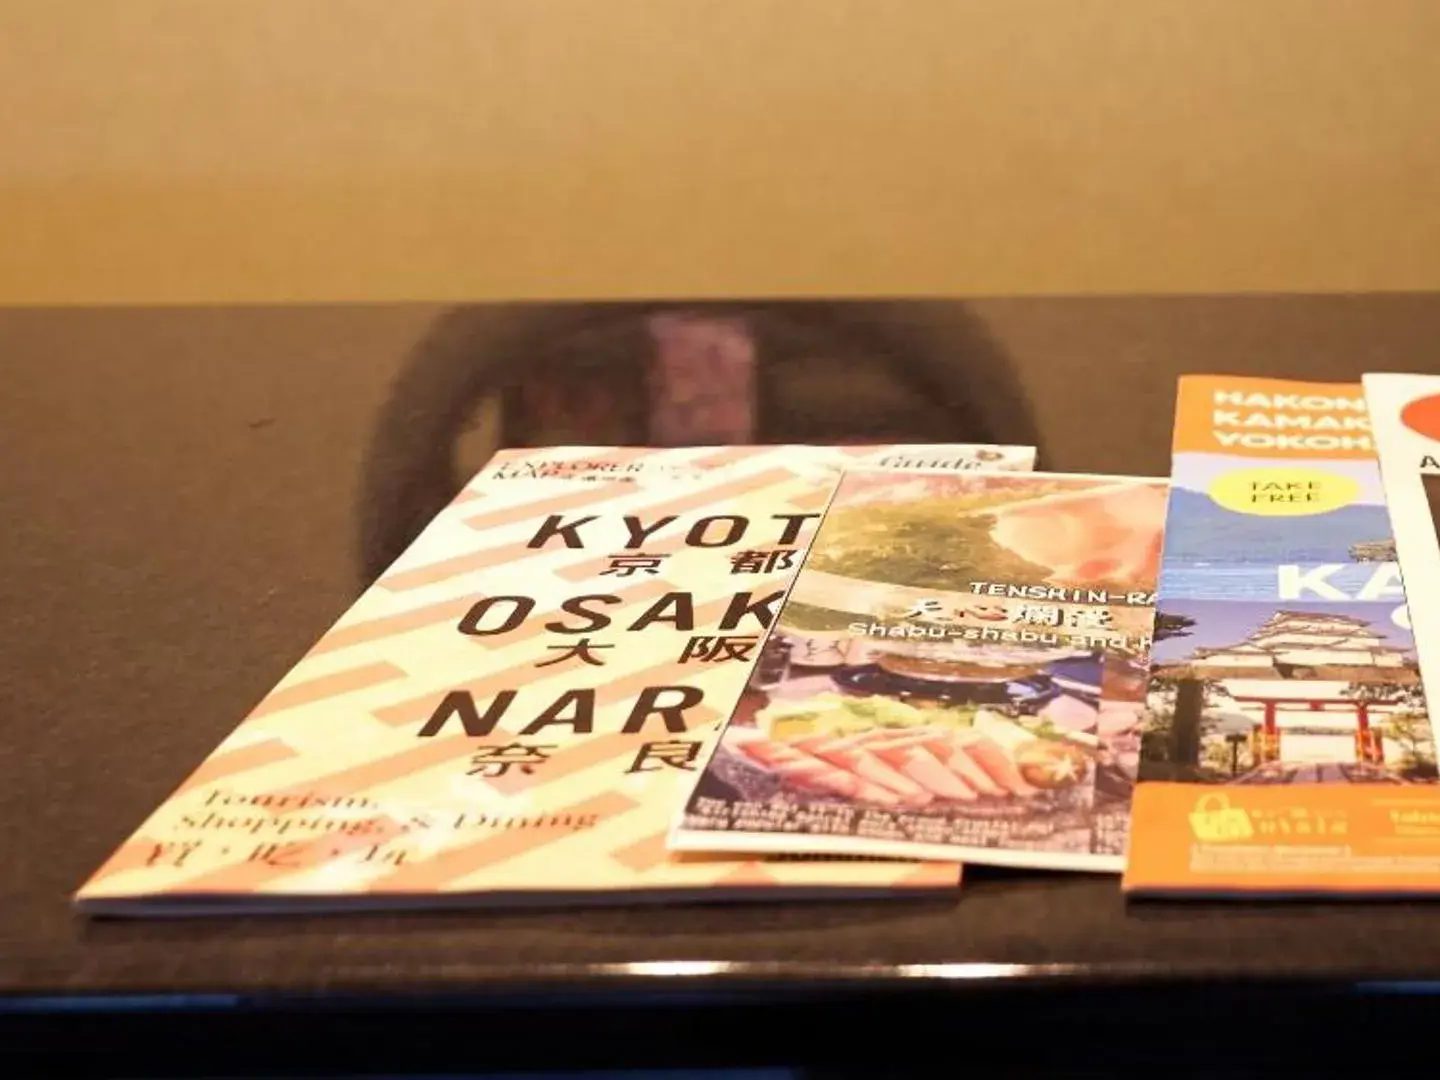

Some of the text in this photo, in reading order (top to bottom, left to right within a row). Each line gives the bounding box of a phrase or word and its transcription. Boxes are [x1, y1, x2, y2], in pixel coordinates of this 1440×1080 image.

[1213, 391, 1367, 412] HAKON
[1250, 481, 1322, 491] TAKE
[1250, 493, 1321, 503] FREE
[527, 513, 820, 549] KYOT
[599, 549, 798, 577] 京都
[456, 590, 787, 636] OSAK
[534, 635, 760, 667] 大阪
[417, 685, 722, 738] NAR
[466, 740, 704, 777] 奈良
